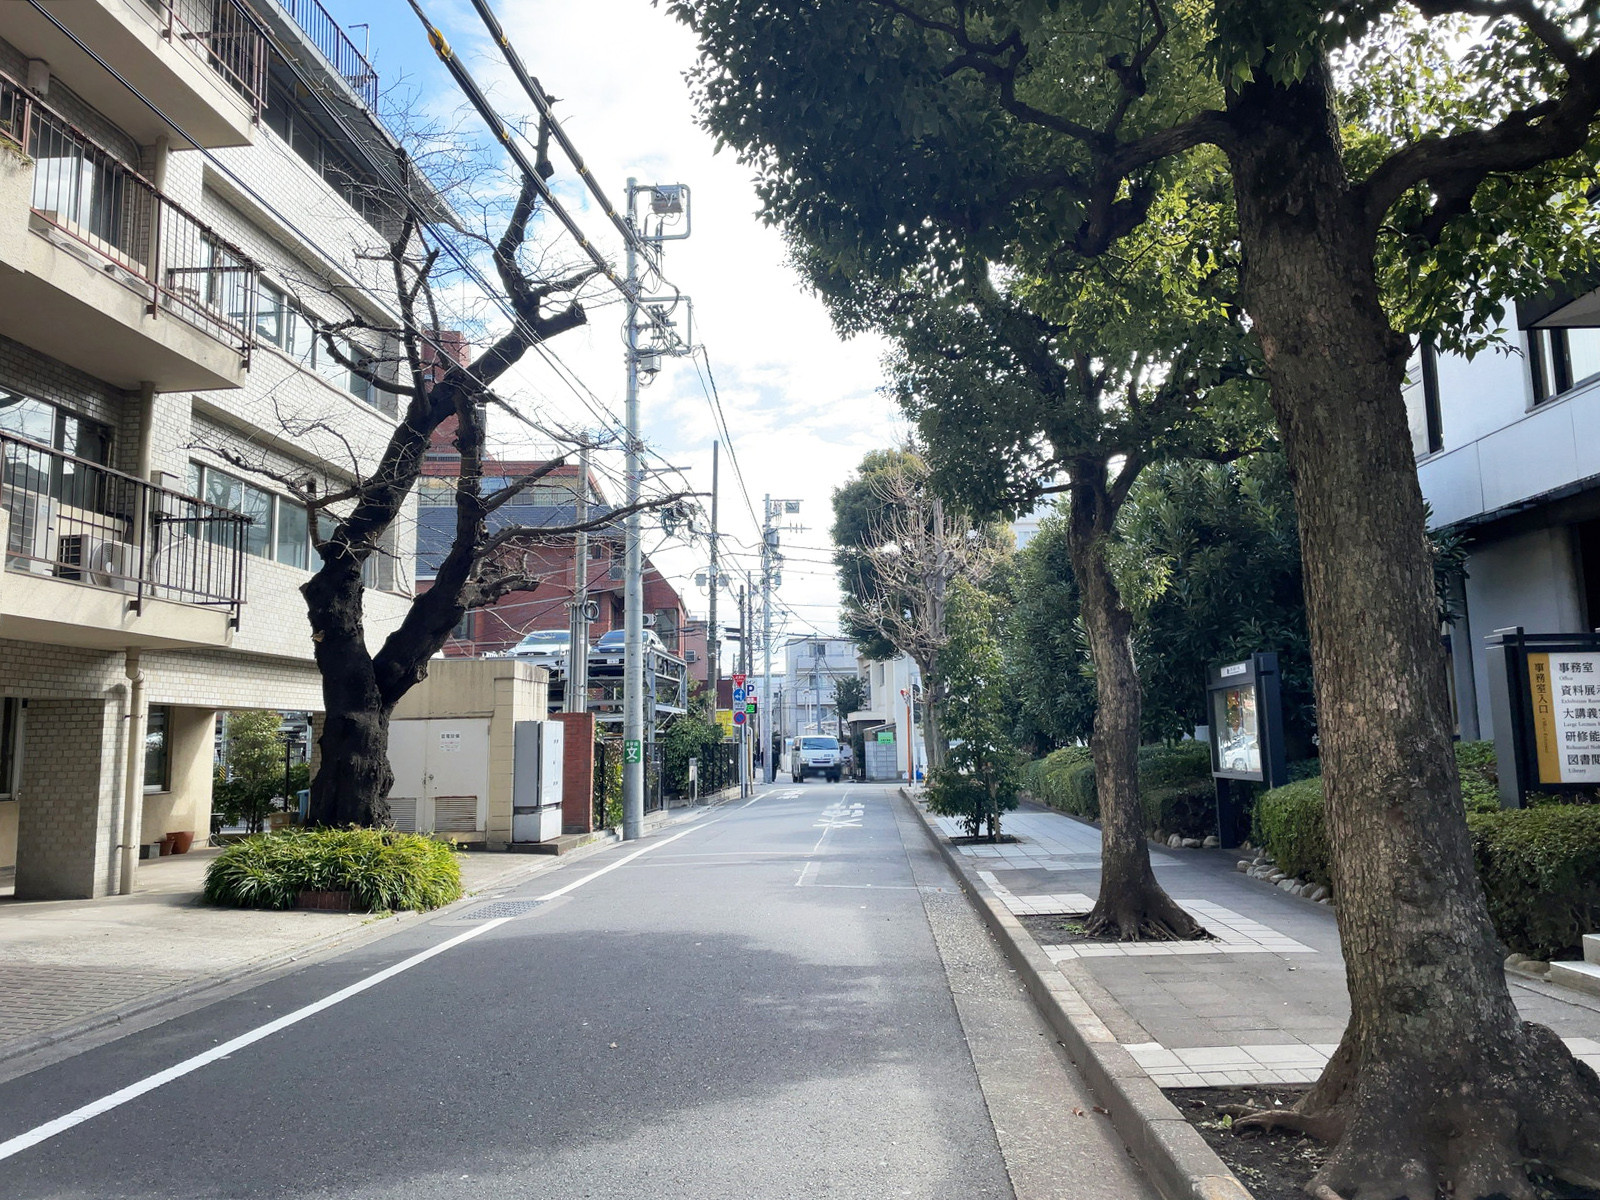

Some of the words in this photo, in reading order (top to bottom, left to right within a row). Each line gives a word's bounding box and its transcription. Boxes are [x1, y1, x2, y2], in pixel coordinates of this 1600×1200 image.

[1559, 662, 1593, 673] 事務室
[747, 685, 754, 696] P
[1534, 663, 1548, 713] 事務室入口
[1563, 707, 1600, 719] 大講義
[1565, 730, 1600, 742] 研修能
[626, 746, 638, 760] 文
